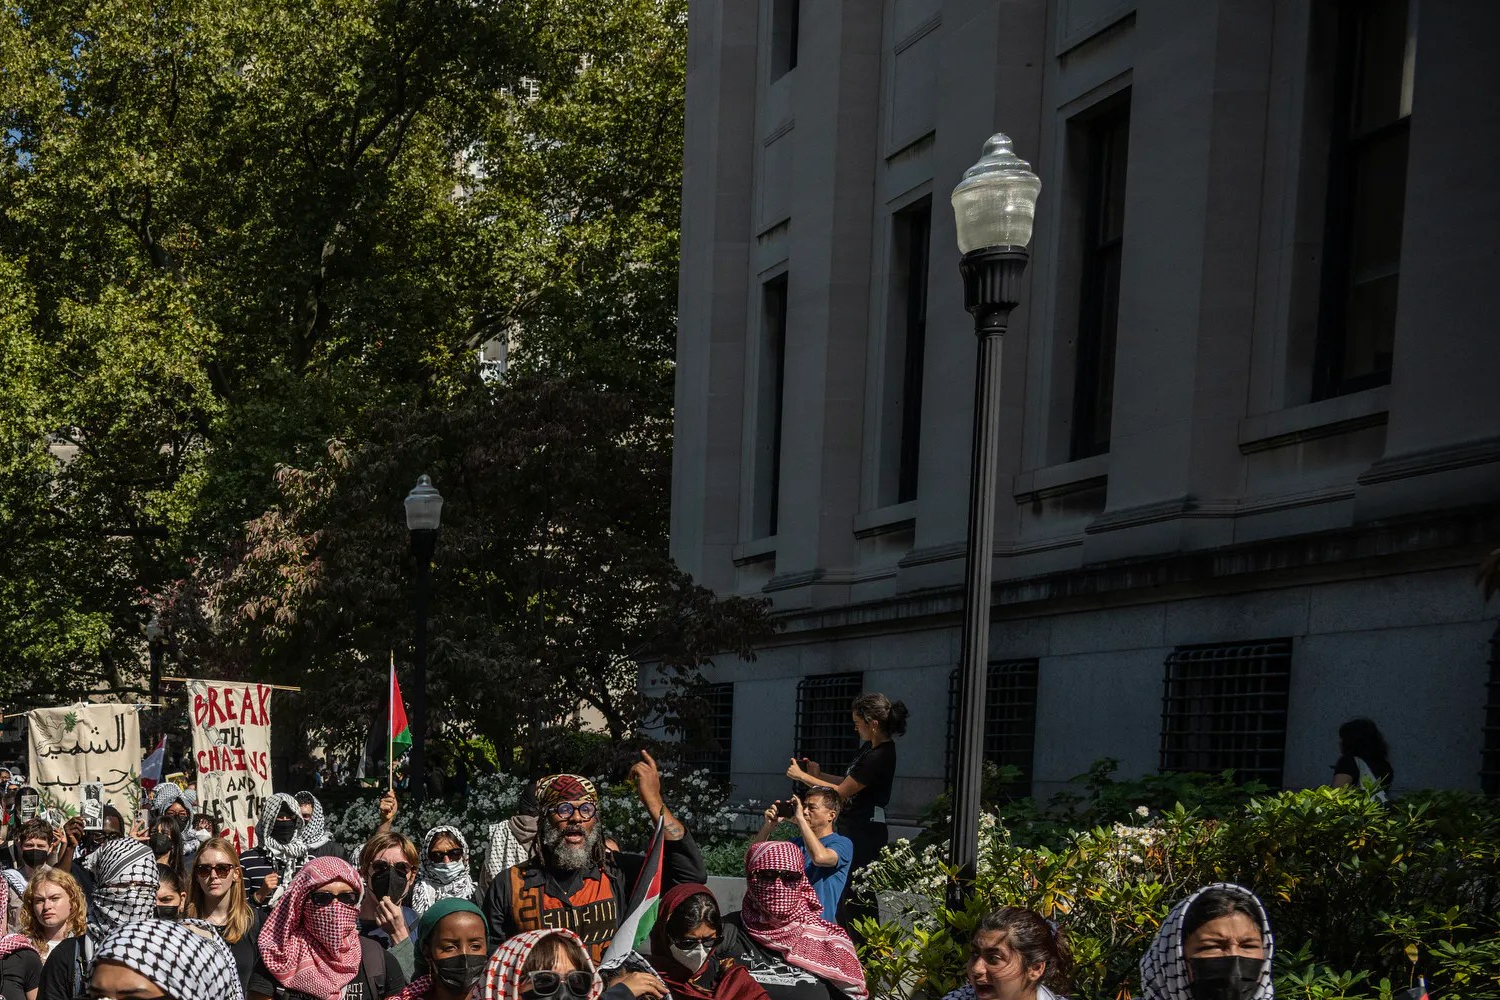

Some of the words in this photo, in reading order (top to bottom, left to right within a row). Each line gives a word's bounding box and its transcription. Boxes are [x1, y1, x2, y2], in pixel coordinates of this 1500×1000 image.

[194, 683, 271, 728] BREAK
[197, 746, 268, 781] CHAINS
[36, 769, 129, 792] حيب
[226, 776, 256, 792] AND
